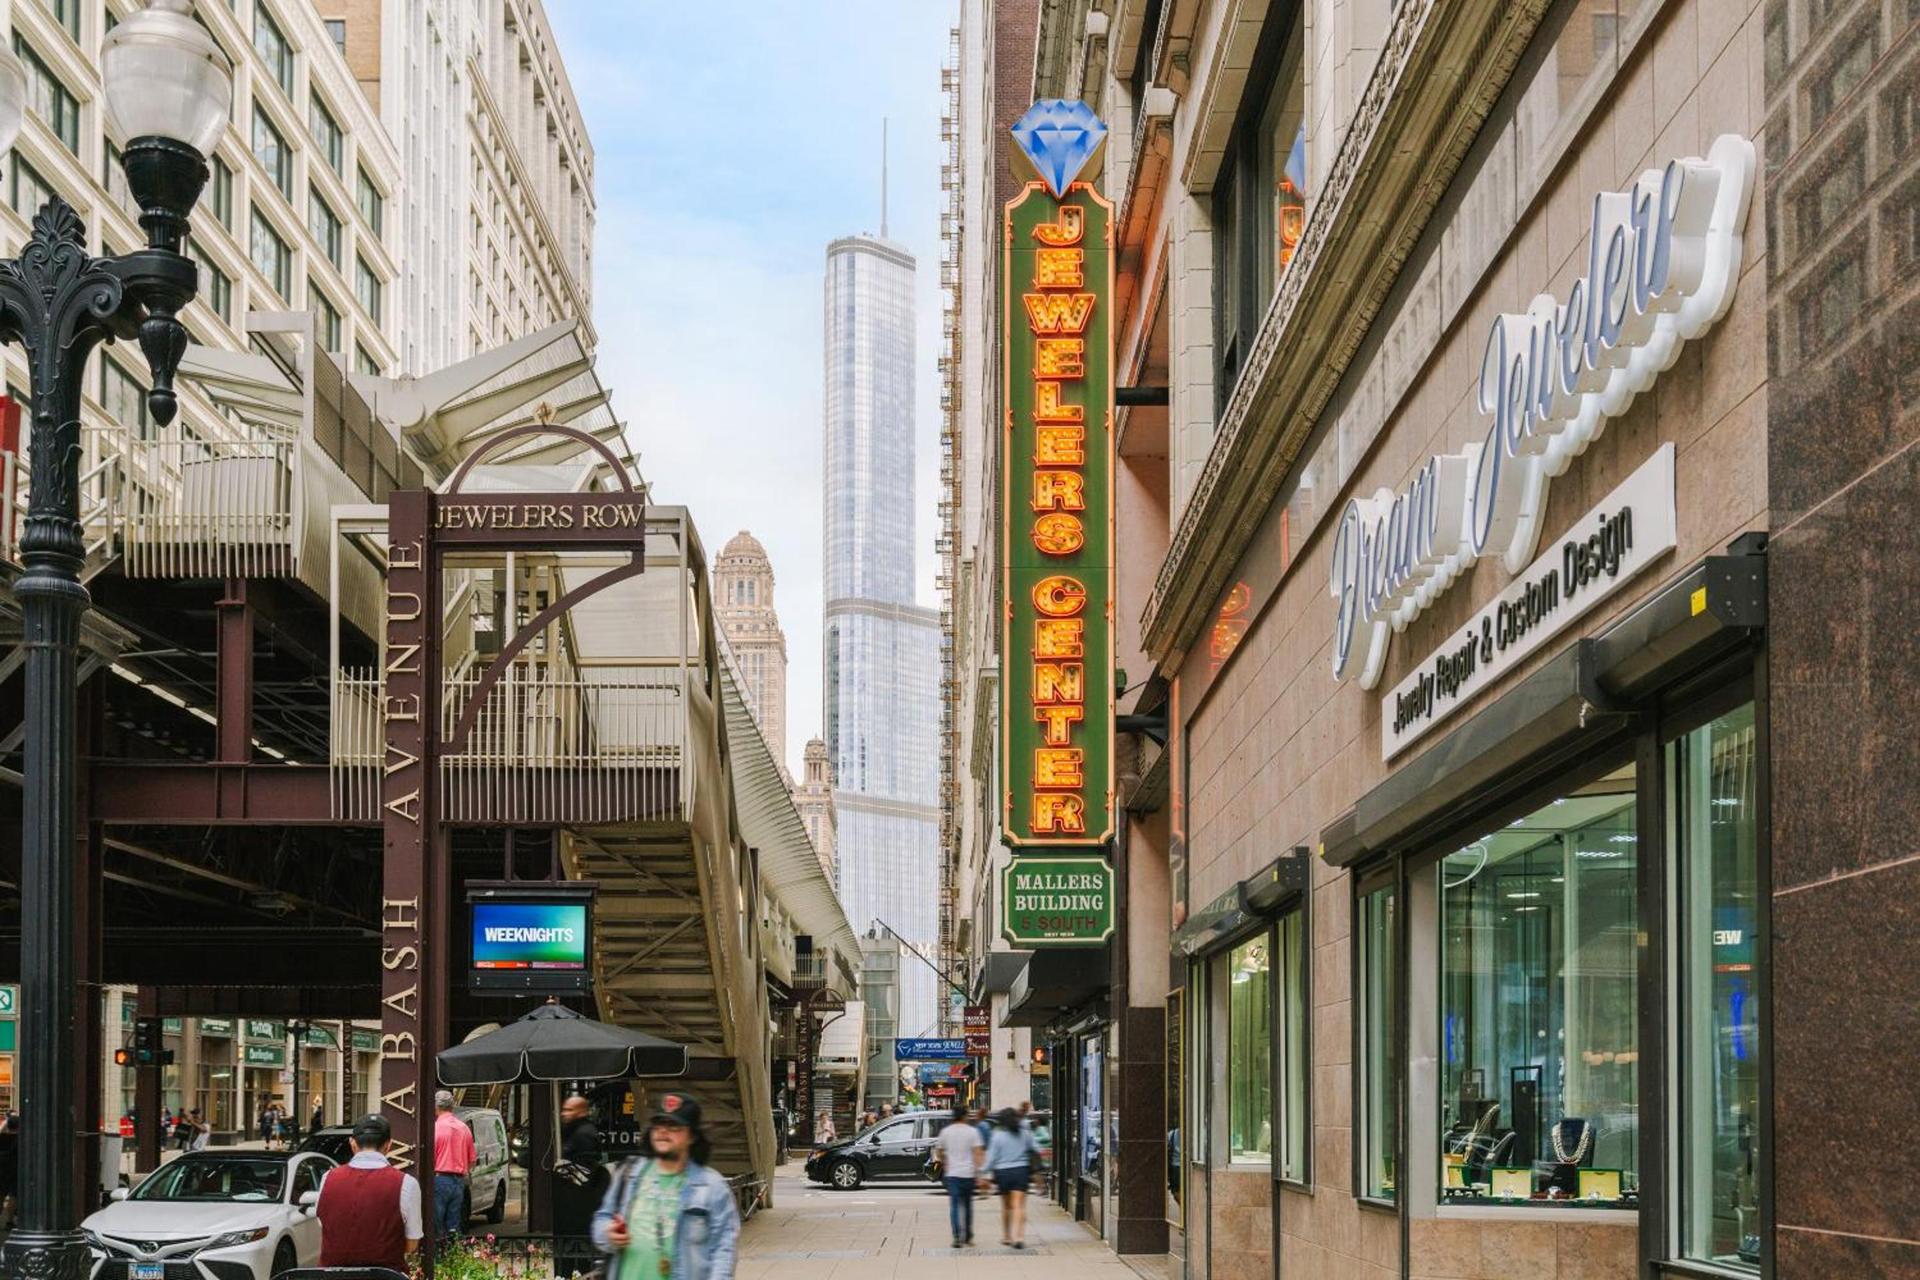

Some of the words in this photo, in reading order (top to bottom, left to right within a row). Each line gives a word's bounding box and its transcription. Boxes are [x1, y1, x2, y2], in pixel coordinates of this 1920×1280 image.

[1023, 205, 1096, 555] JEWELERS
[1331, 452, 1455, 683] Dream
[1473, 148, 1705, 562] Jewelers
[435, 504, 574, 529] JEWELERS
[582, 503, 645, 528] ROW
[1393, 672, 1435, 734] Jewelry
[1435, 631, 1479, 699] Repair
[1480, 615, 1494, 664] &
[1496, 568, 1560, 651] Custom
[1562, 505, 1634, 598] Design
[384, 541, 423, 824] AVENUE
[1031, 575, 1087, 834] CENTER
[484, 926, 575, 942] WEEKNIGHTS
[1015, 874, 1104, 890] MALLERS
[1015, 894, 1105, 911] BUILDING
[1038, 915, 1097, 930] SOUTH
[380, 895, 418, 1171] WABASH
